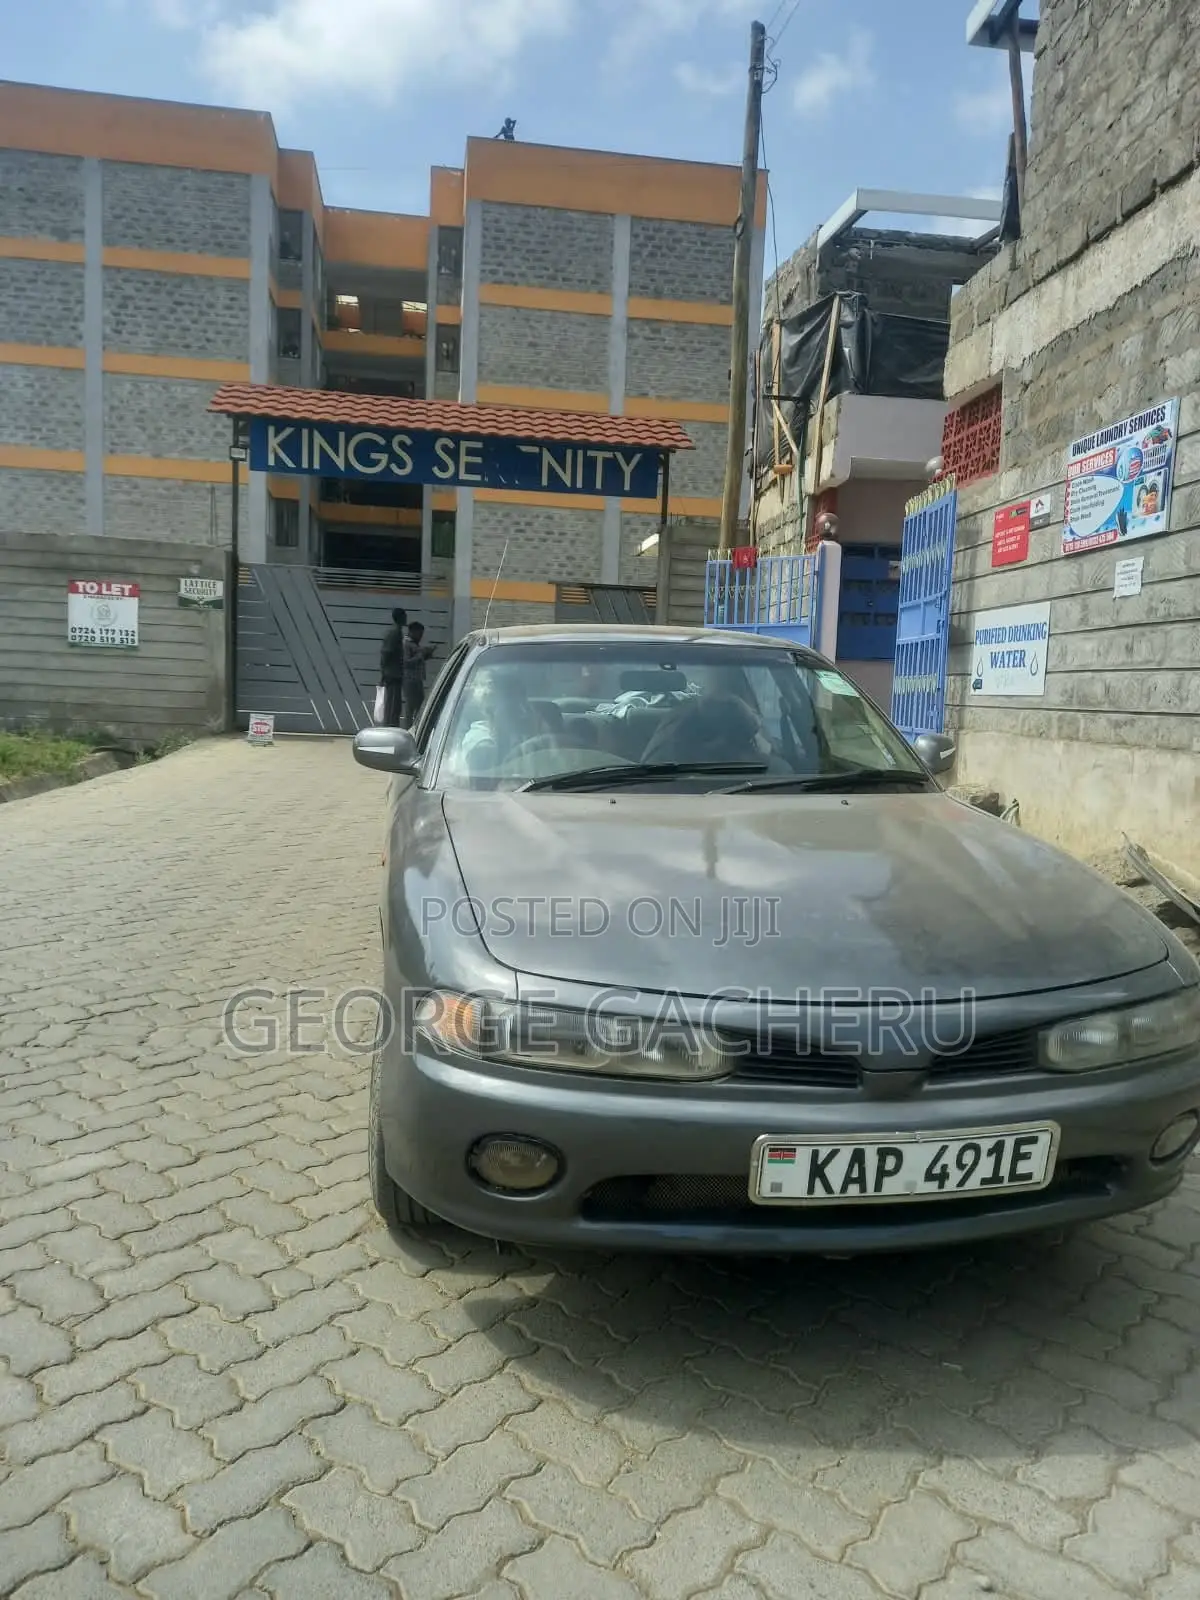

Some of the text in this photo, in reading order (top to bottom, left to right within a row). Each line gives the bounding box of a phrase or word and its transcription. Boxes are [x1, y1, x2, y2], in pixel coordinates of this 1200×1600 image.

[1072, 438, 1096, 457] UNIQUE
[1096, 423, 1128, 447] LAUNDRY
[1128, 405, 1166, 435] SERVICES
[267, 424, 643, 491] KINGS SENITY
[1081, 450, 1114, 473] SERVICES
[74, 581, 133, 596] TO LET
[184, 579, 217, 588] LATTICE
[184, 587, 217, 596] SECURITY
[70, 635, 96, 643] 0720
[975, 622, 1047, 646] PURIFIED DRINKING
[990, 650, 1026, 669] WATER
[806, 1135, 1039, 1195] KAP 491E
